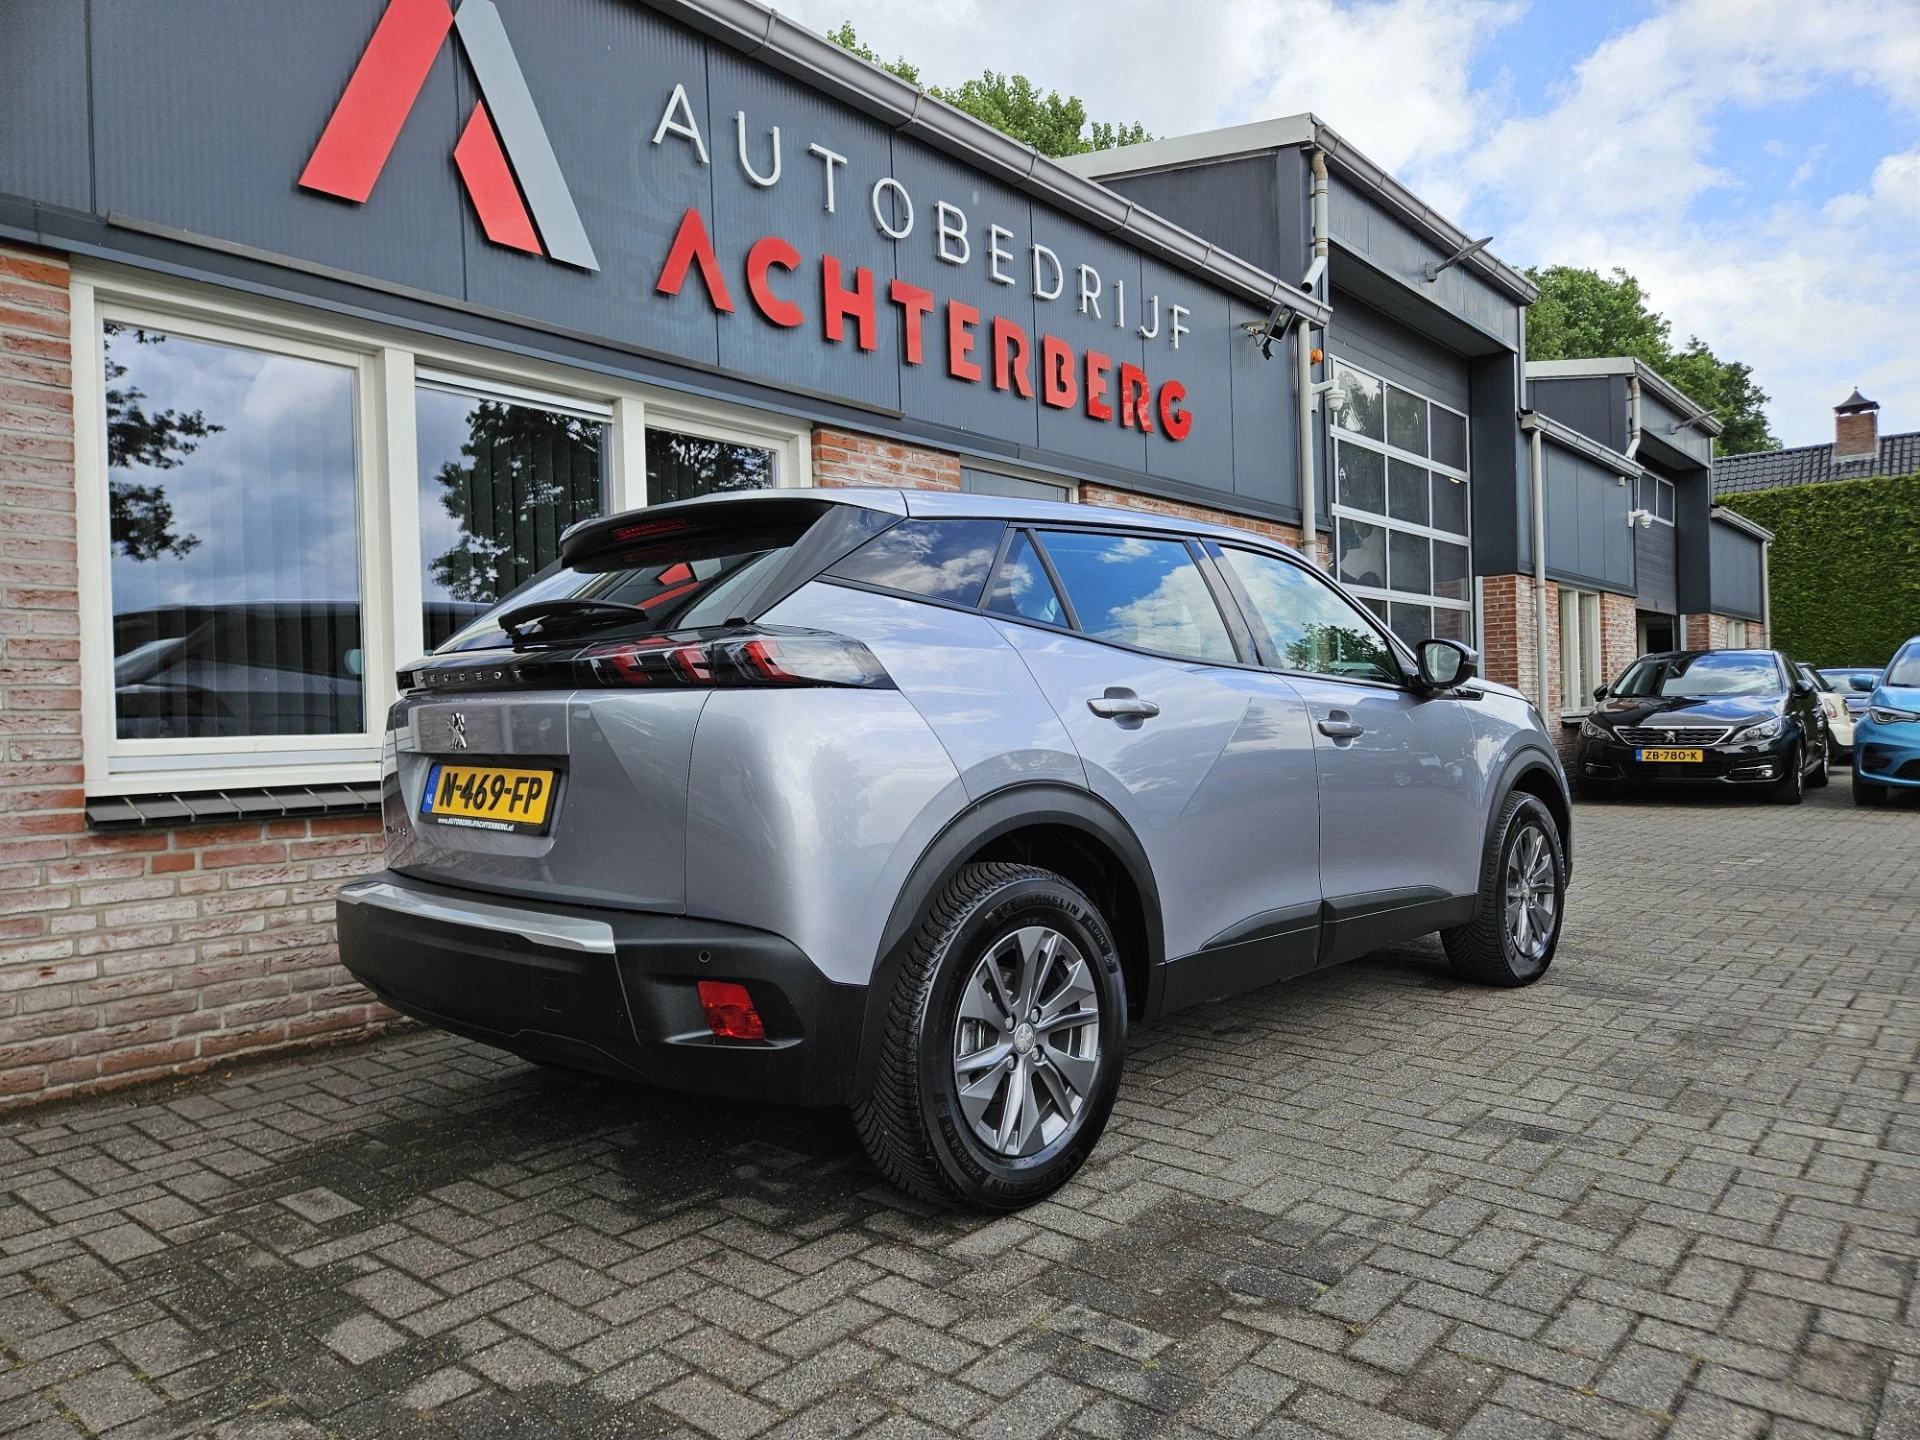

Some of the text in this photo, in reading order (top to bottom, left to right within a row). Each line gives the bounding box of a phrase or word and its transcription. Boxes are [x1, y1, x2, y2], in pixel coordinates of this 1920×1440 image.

[652, 83, 1191, 349] AUTOBEDRIJF
[656, 208, 1193, 441] ACHTERBERG
[439, 772, 543, 815] N-469-FP
[1645, 751, 1698, 761] ZB-780-K
